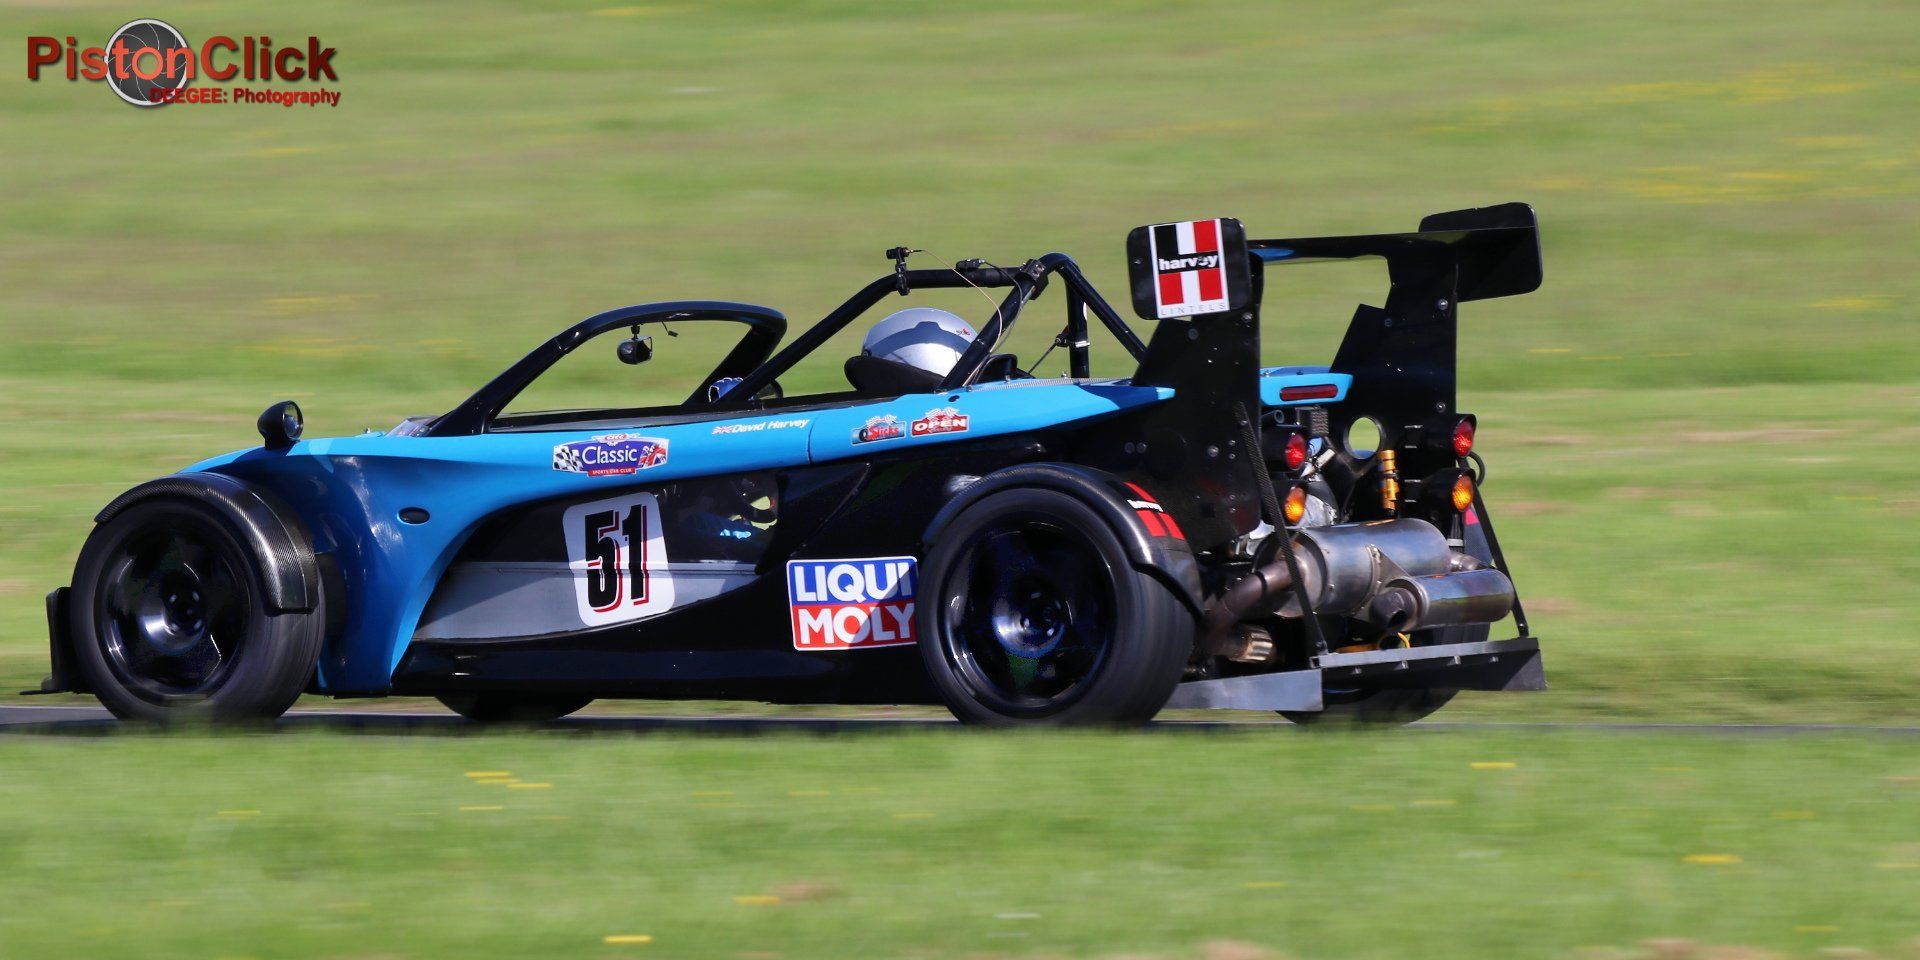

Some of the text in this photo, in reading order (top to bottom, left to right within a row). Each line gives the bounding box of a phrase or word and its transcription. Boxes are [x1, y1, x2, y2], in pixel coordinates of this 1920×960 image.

[1158, 255, 1219, 270] harvey
[1161, 302, 1226, 315] LINTELS
[731, 419, 811, 433] David Harvey
[914, 418, 966, 432] OPEN
[582, 445, 638, 465] Classic
[584, 503, 651, 613] 51
[794, 562, 910, 603] LIQUI
[800, 603, 915, 645] MOLY
